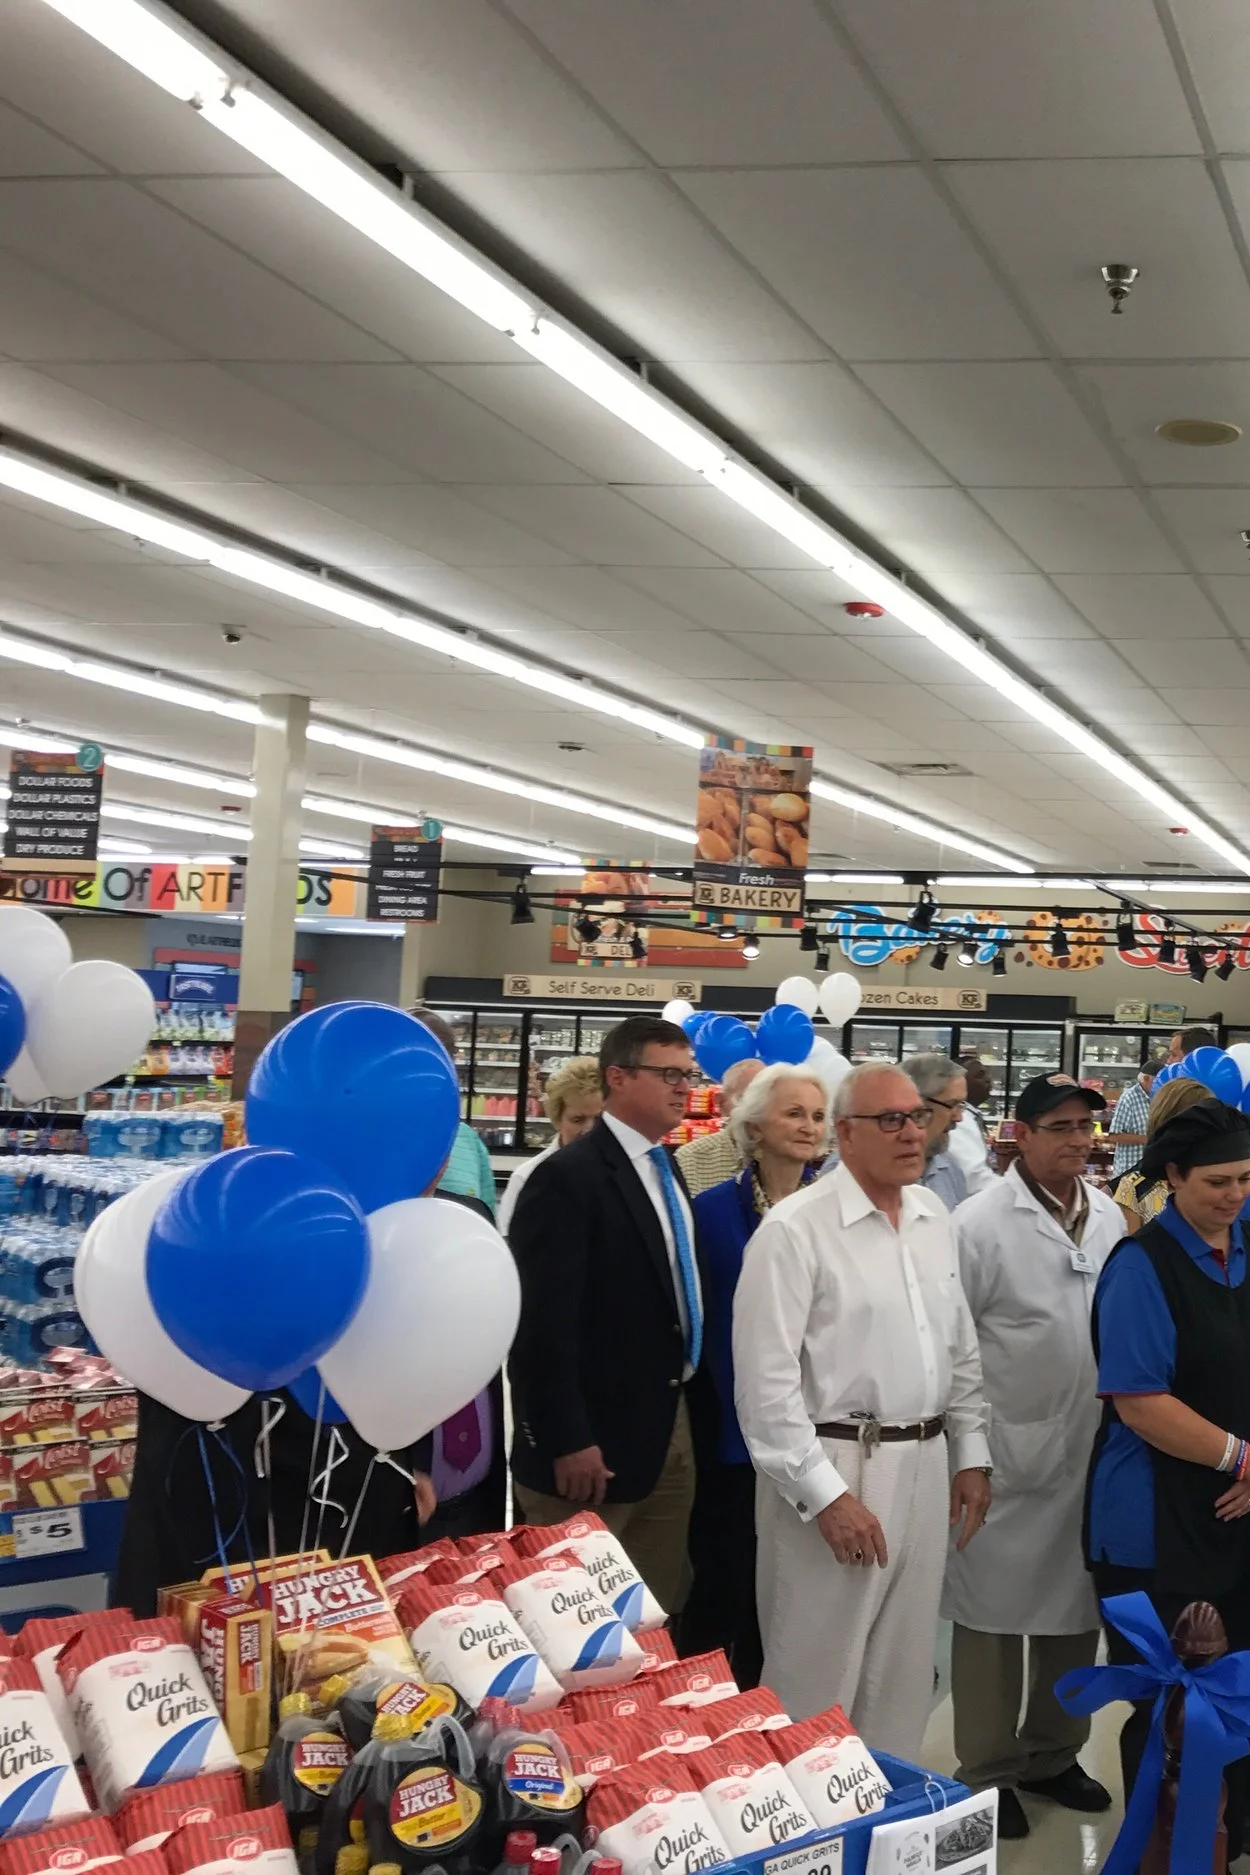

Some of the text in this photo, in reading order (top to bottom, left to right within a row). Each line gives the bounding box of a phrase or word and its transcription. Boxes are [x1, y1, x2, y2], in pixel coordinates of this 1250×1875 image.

[84, 747, 97, 768] 2
[19, 776, 93, 789] DOLLAR FOODS
[13, 792, 50, 803] DOLLAR
[41, 827, 57, 837] OF
[57, 828, 88, 838] VALUE
[103, 866, 152, 902] Of
[738, 872, 776, 886] Fresh
[720, 886, 798, 908] BAKERY
[548, 981, 577, 995] Self
[580, 982, 622, 996] Serve
[626, 983, 655, 997] Deli
[895, 991, 938, 1006] Cakes
[586, 1551, 620, 1577] uick
[271, 1565, 360, 1599] HUNGRY
[598, 1568, 635, 1596] Grits
[275, 1578, 377, 1624] JACK
[551, 1587, 600, 1615] Quick
[578, 1605, 614, 1626] Grits
[459, 1620, 513, 1651] Quick
[488, 1638, 528, 1661] Grits
[127, 1672, 194, 1712] Quick
[157, 1695, 209, 1728] Grits
[1, 1744, 54, 1780] Grits
[302, 1752, 349, 1767] JACK
[513, 1753, 558, 1766] HUNGRY
[513, 1762, 562, 1779] JACK
[399, 1774, 450, 1801] HUNGRY
[825, 1761, 876, 1804] Quick
[400, 1785, 454, 1817] JACK
[740, 1789, 791, 1834] Quick
[855, 1781, 890, 1814] Grits
[769, 1810, 808, 1845] Grits
[654, 1822, 709, 1871] Quick
[684, 1844, 727, 1875] Grits
[780, 1854, 811, 1871] QUICK
[811, 1842, 840, 1860] GRITS
